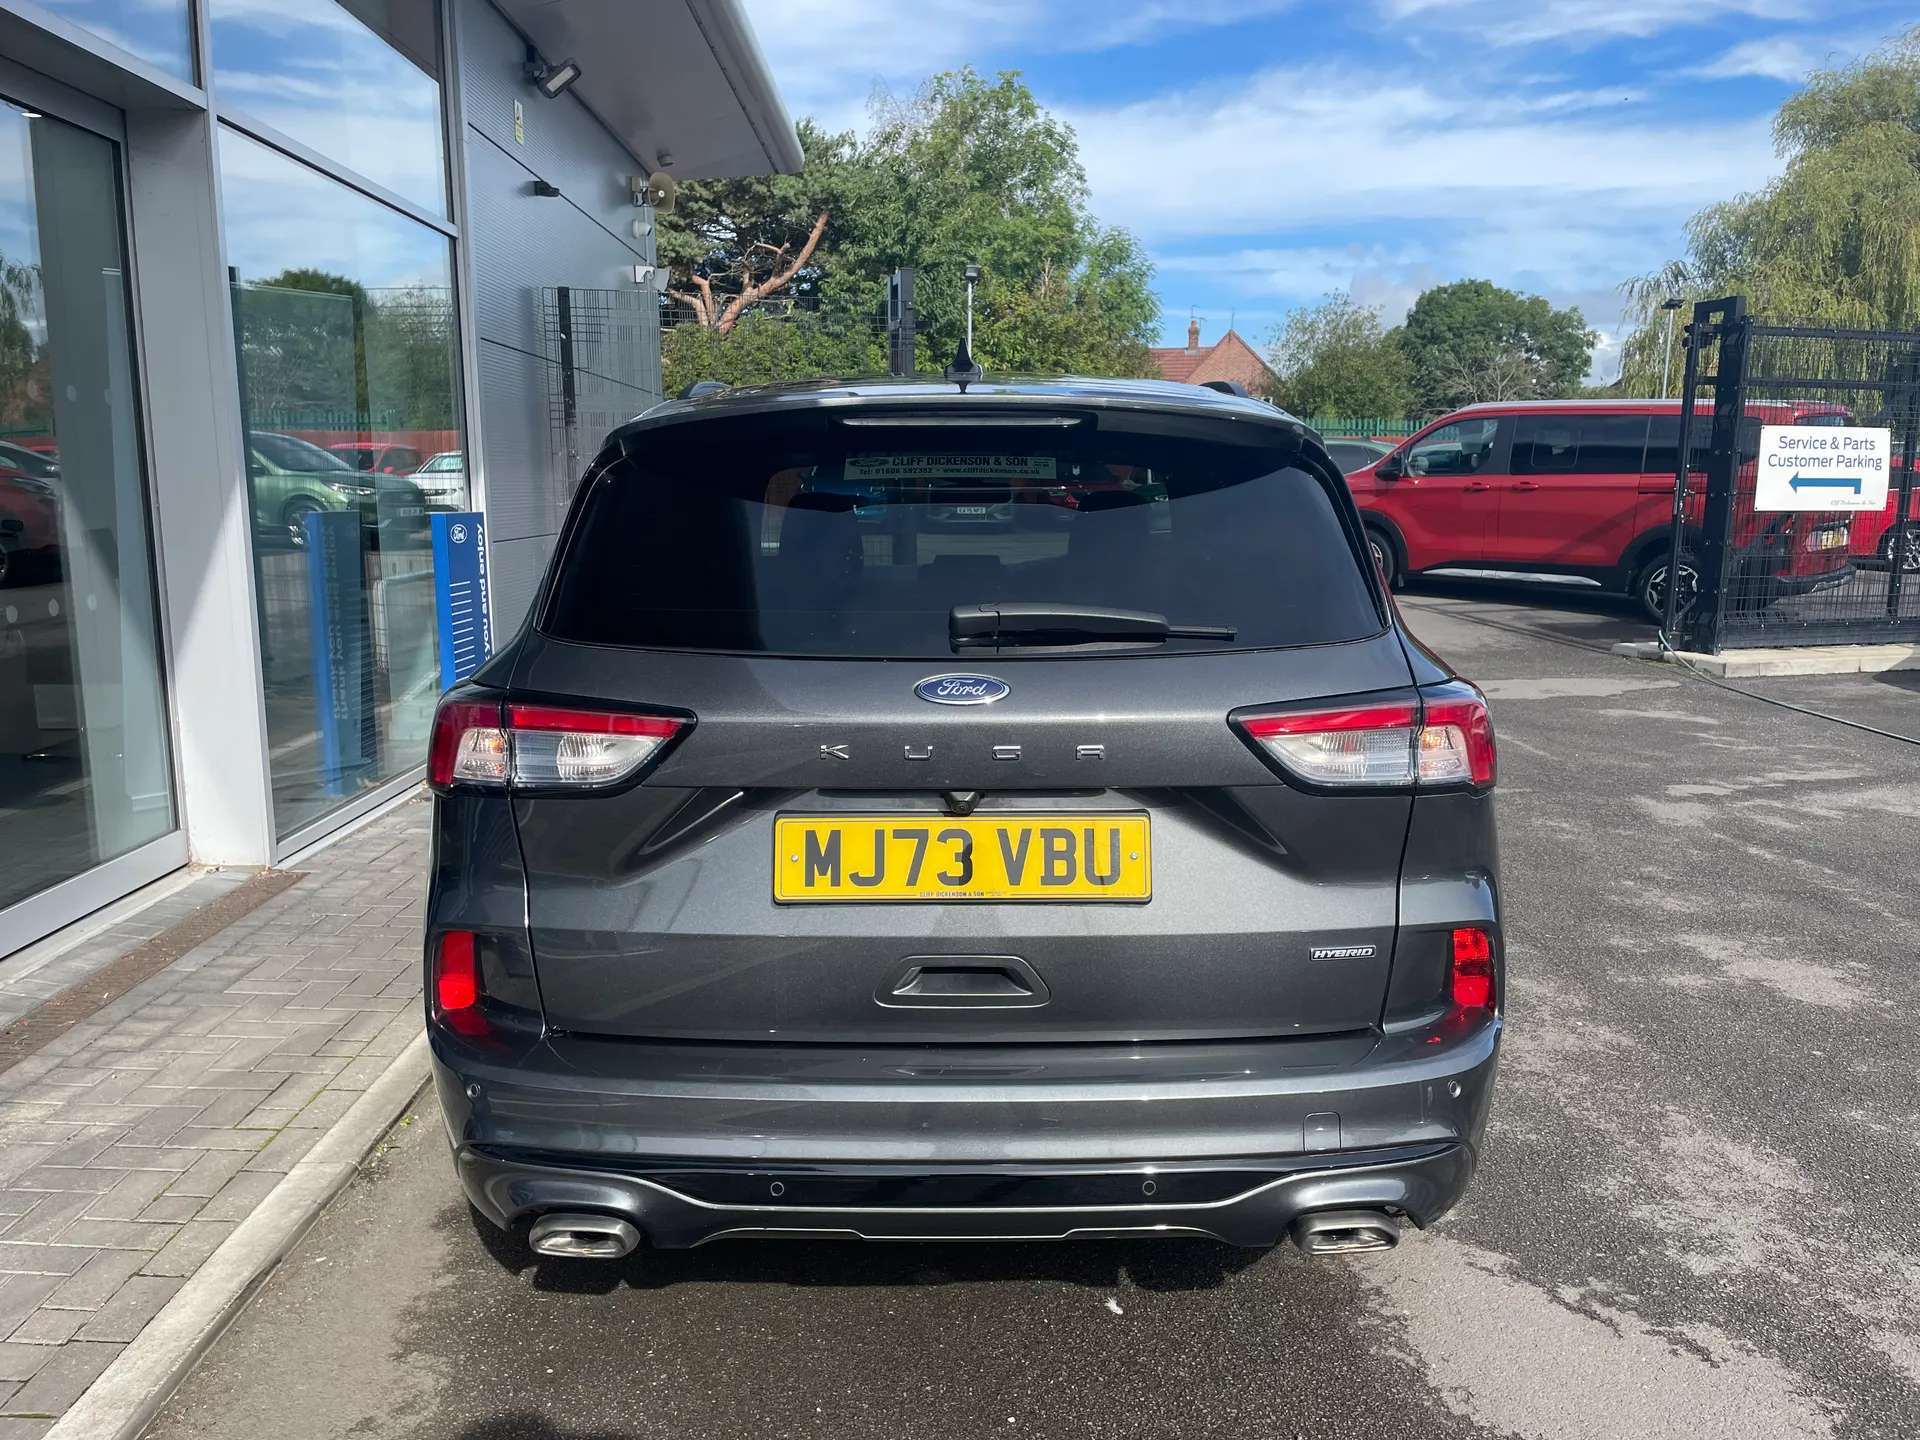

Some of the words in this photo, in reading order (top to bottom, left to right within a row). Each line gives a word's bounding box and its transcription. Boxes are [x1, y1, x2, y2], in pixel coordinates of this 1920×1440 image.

[1778, 435, 1827, 450] Service
[1830, 436, 1840, 450] &
[1843, 436, 1876, 451] Parts
[892, 456, 926, 466] CLIFF
[927, 456, 991, 466] DICKENSON
[993, 457, 1002, 466] &
[1005, 457, 1028, 466] SON
[1768, 454, 1833, 468] Customer
[1836, 454, 1882, 471] Parking
[476, 523, 485, 576] enjoy
[479, 578, 487, 614] and
[482, 620, 491, 655] you
[937, 678, 987, 696] Ford
[820, 744, 1105, 760] KUGA
[804, 828, 973, 887] MJ73
[996, 828, 1121, 887] VBU
[1313, 948, 1373, 958] HYBRID
